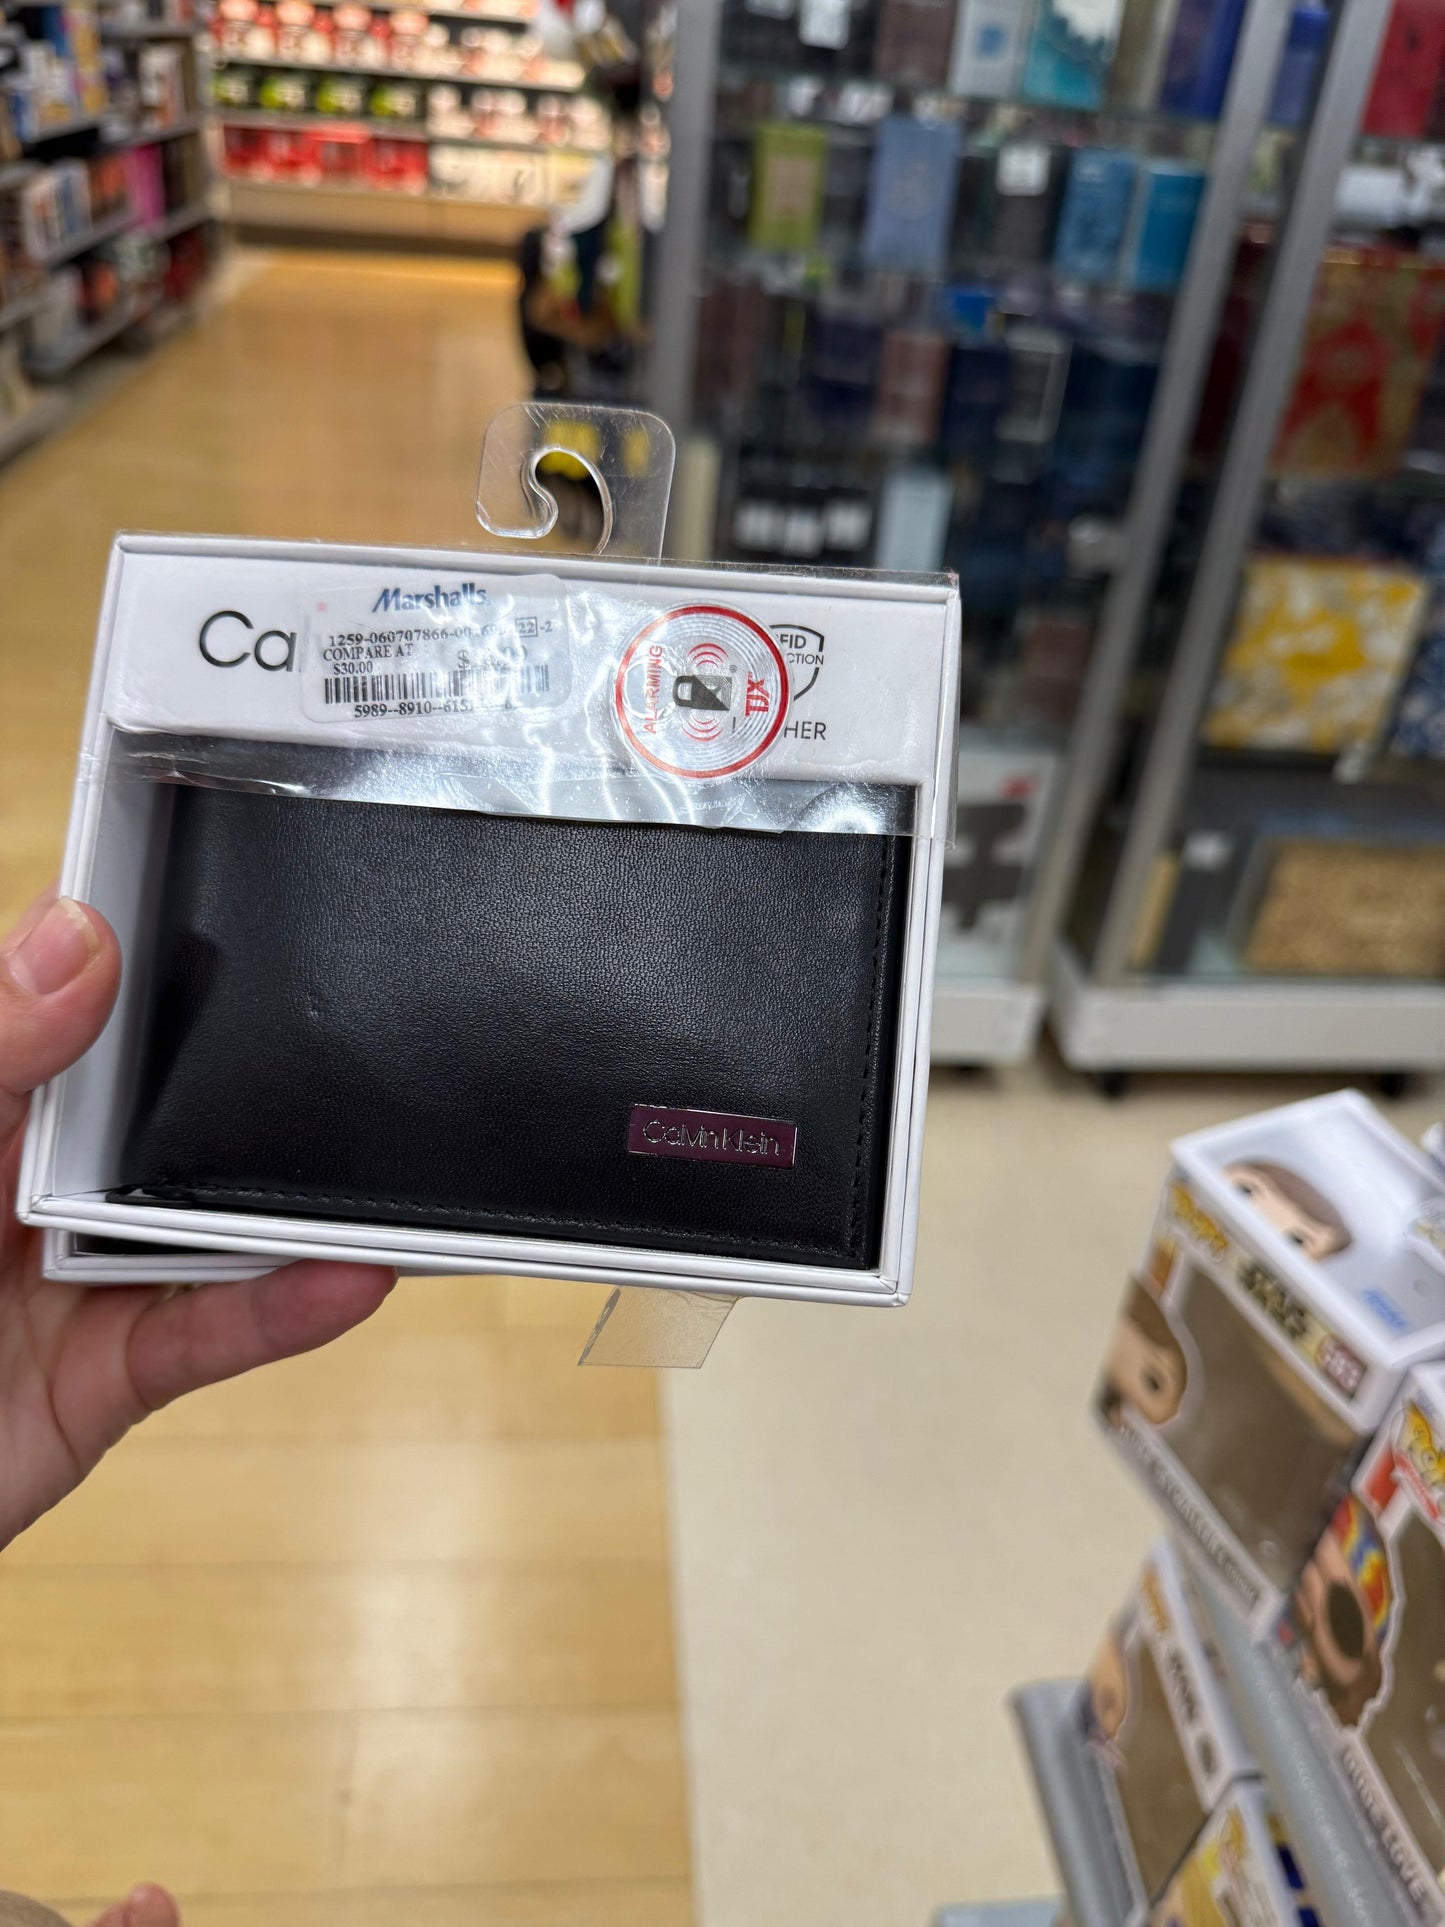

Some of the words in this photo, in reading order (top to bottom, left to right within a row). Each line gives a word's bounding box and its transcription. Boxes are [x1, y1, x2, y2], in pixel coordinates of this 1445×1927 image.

[372, 582, 490, 613] Marshalls
[777, 633, 807, 650] FID
[323, 644, 392, 661] COMPARE
[396, 643, 413, 657] AT
[333, 661, 373, 676] $30.00
[643, 645, 663, 735] ALARMING
